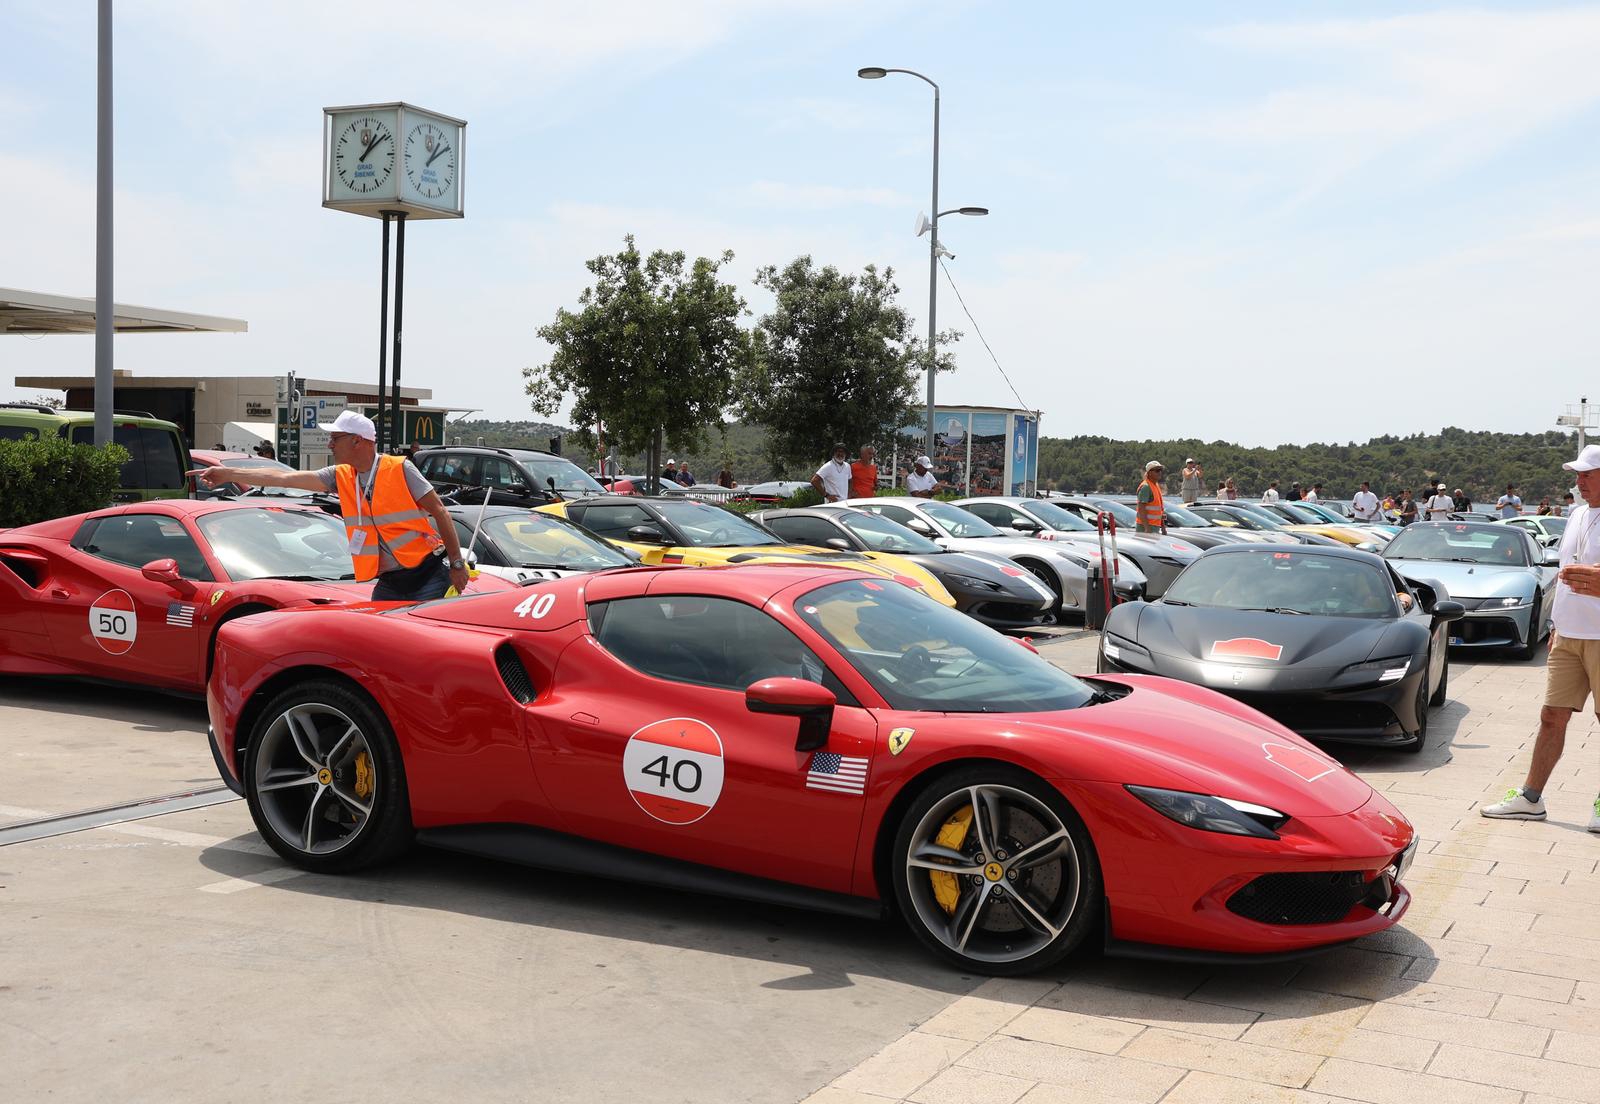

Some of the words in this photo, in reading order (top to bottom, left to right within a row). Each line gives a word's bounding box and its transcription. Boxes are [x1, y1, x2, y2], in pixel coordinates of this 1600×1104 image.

[304, 408, 315, 425] P
[513, 593, 556, 619] 40
[99, 613, 127, 635] 50
[641, 755, 702, 793] 40
